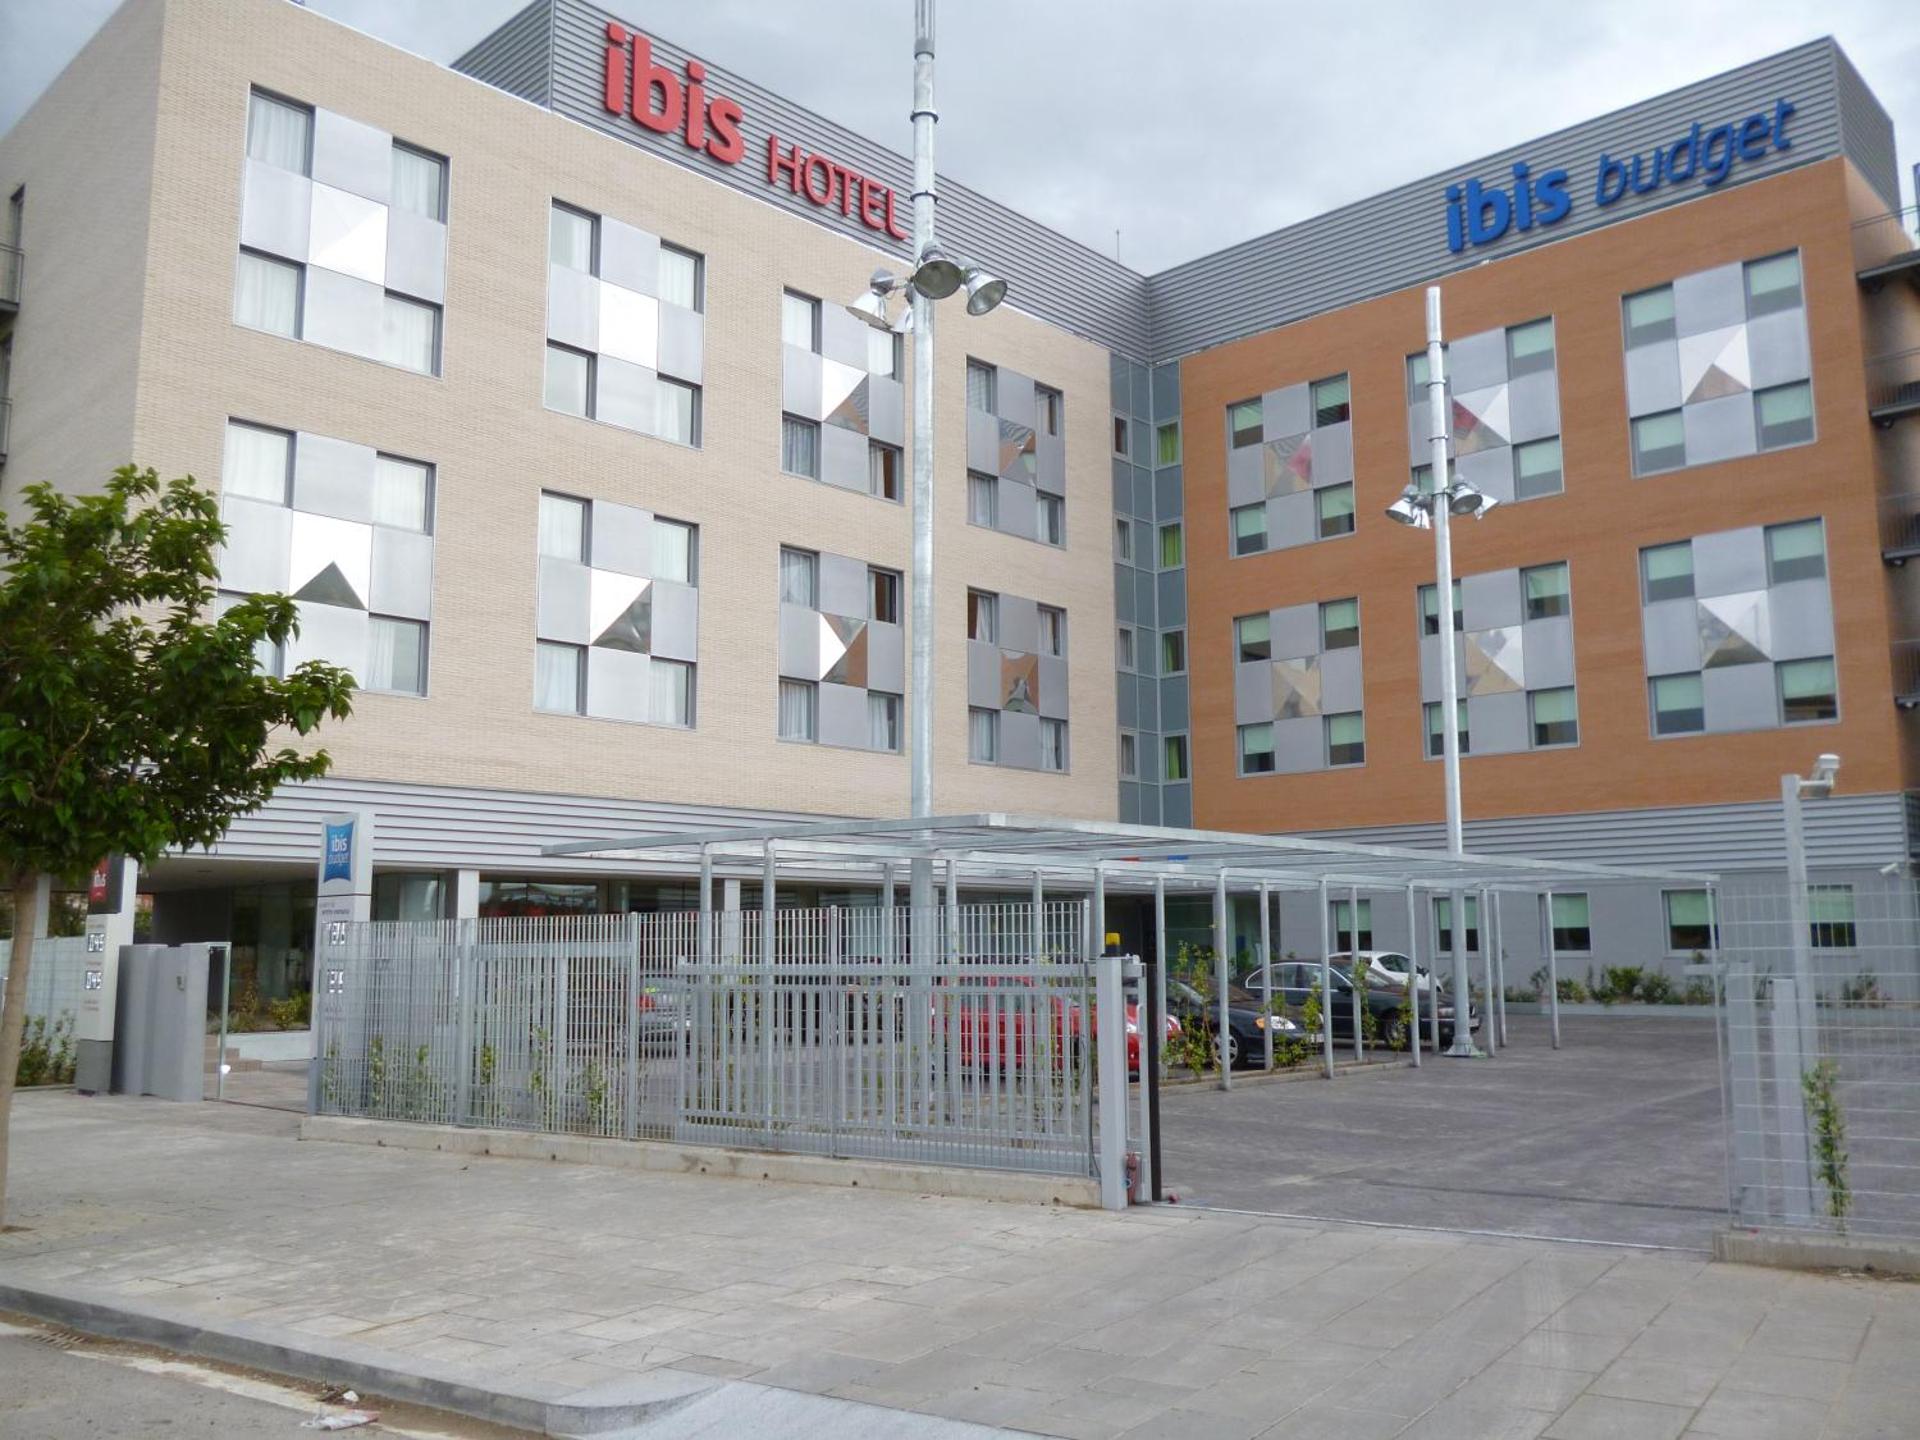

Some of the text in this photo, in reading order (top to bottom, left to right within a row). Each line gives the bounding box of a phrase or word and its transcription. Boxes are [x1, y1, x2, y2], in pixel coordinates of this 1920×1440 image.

[602, 20, 908, 241] ibis HOTEL
[1445, 97, 1795, 254] ibis budget
[331, 833, 348, 852] ibis
